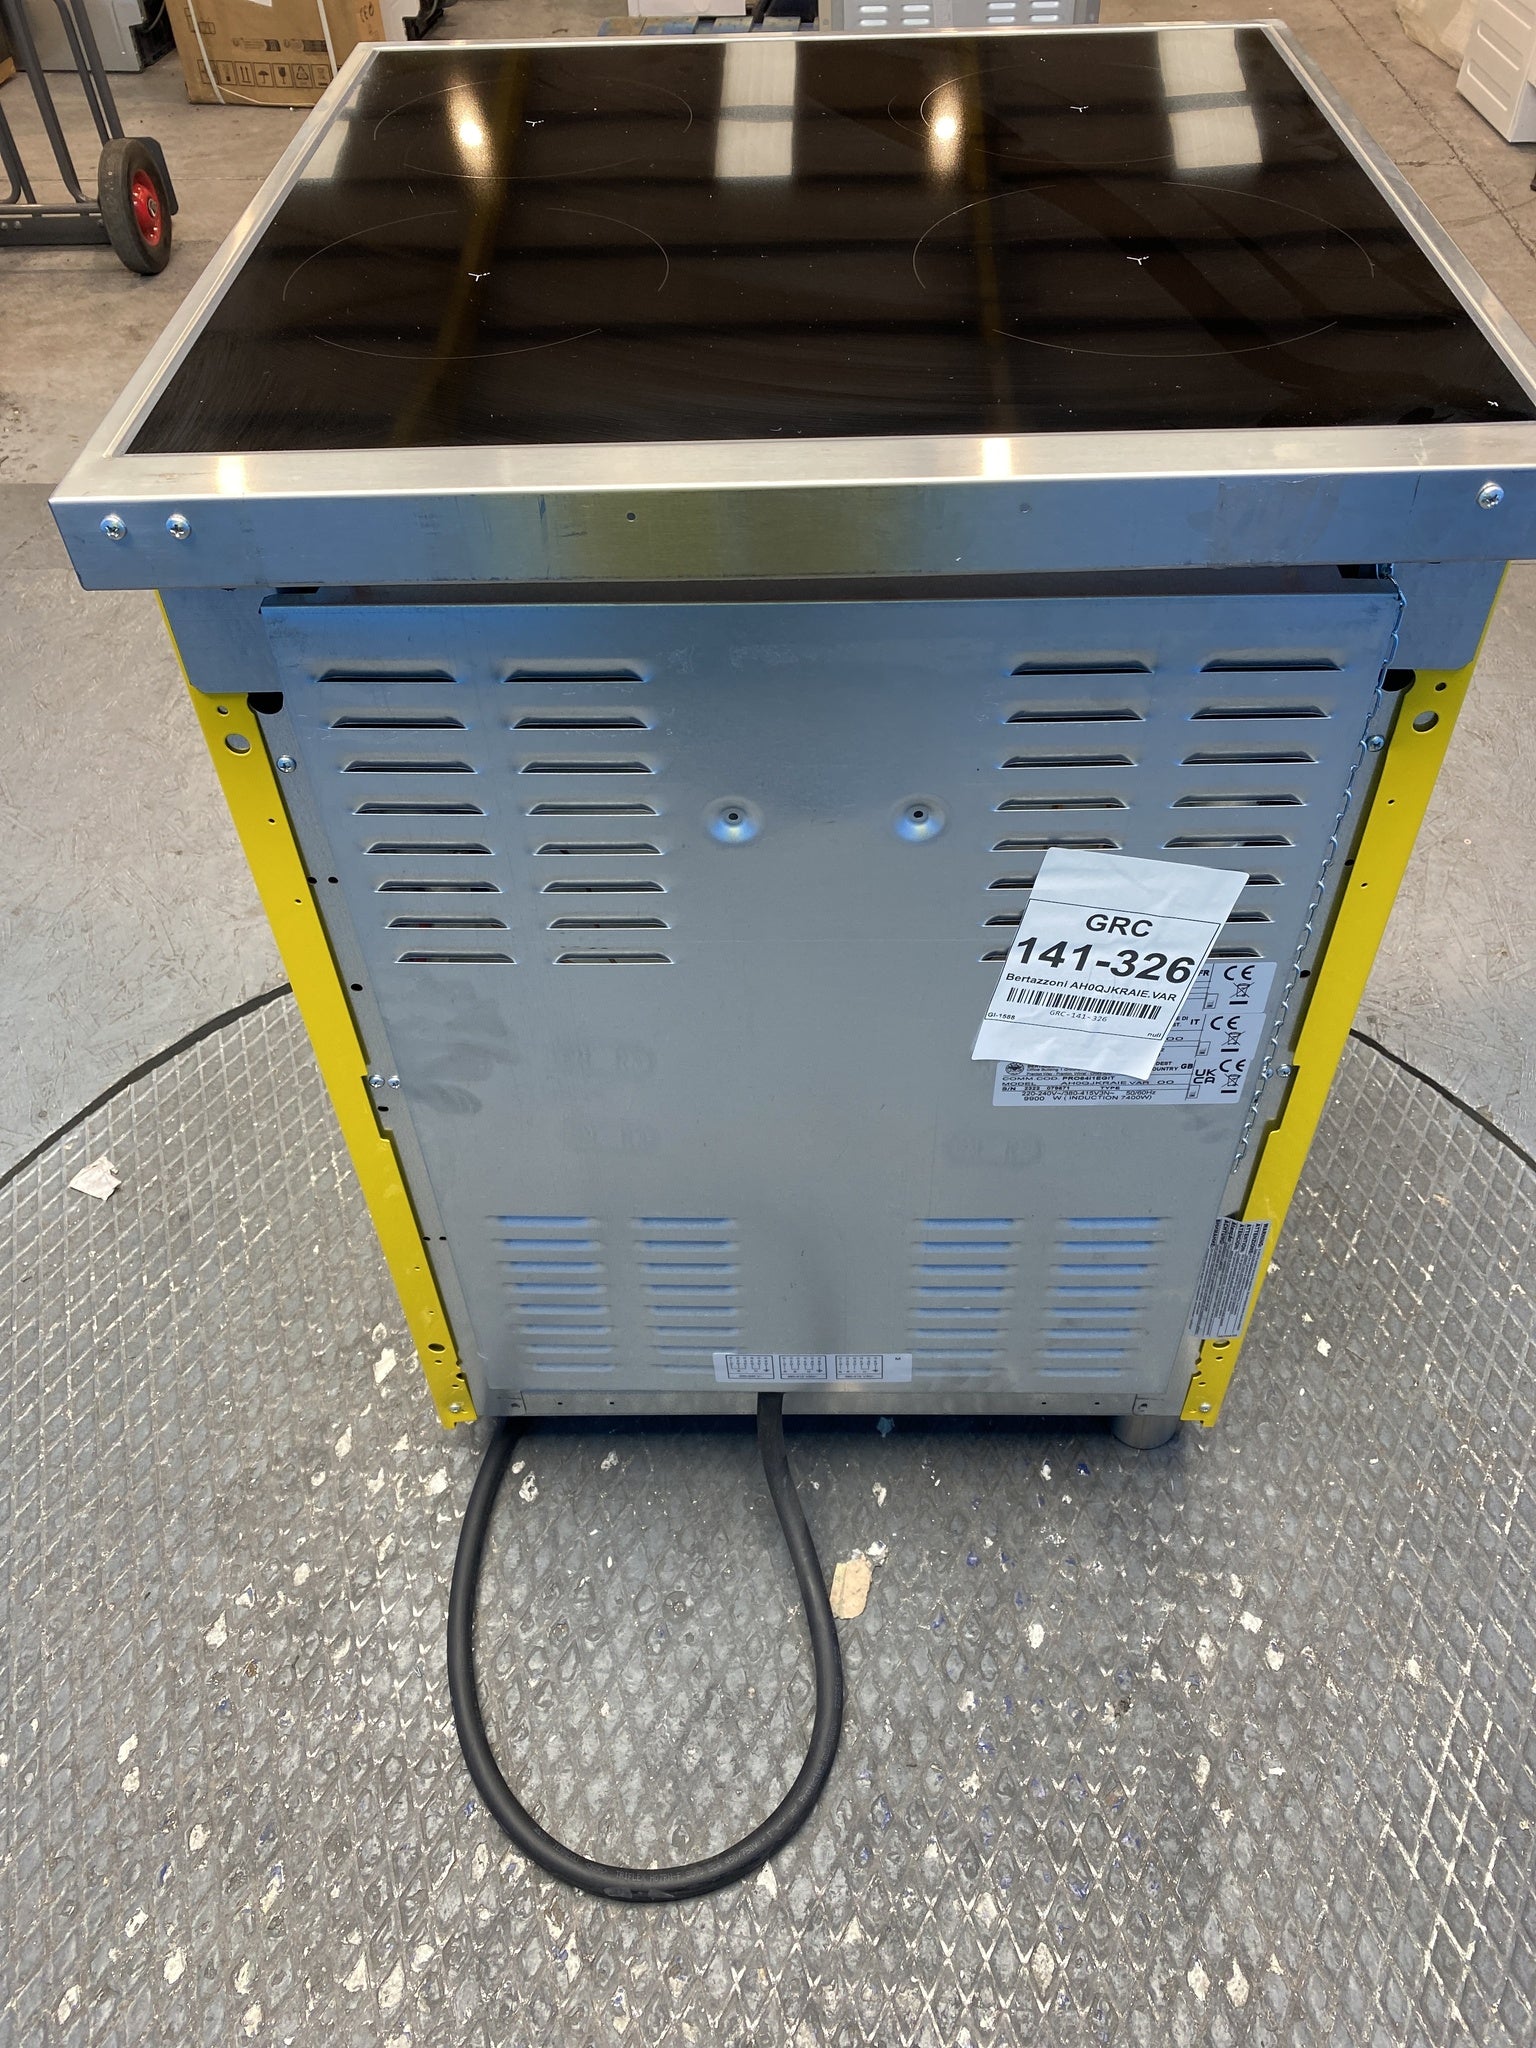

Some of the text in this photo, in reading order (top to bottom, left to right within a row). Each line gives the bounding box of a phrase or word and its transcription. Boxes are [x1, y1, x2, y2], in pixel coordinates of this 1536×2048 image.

[1086, 913, 1154, 938] GRC
[1017, 936, 1196, 984] 141-326
[1006, 973, 1068, 989] Bertazzoni
[1049, 1009, 1108, 1023] GRC-141-326
[1190, 1018, 1201, 1026] IT
[1194, 1068, 1217, 1077] UK
[1193, 1076, 1216, 1085] CA
[615, 1870, 647, 1882] TRIFLEX
